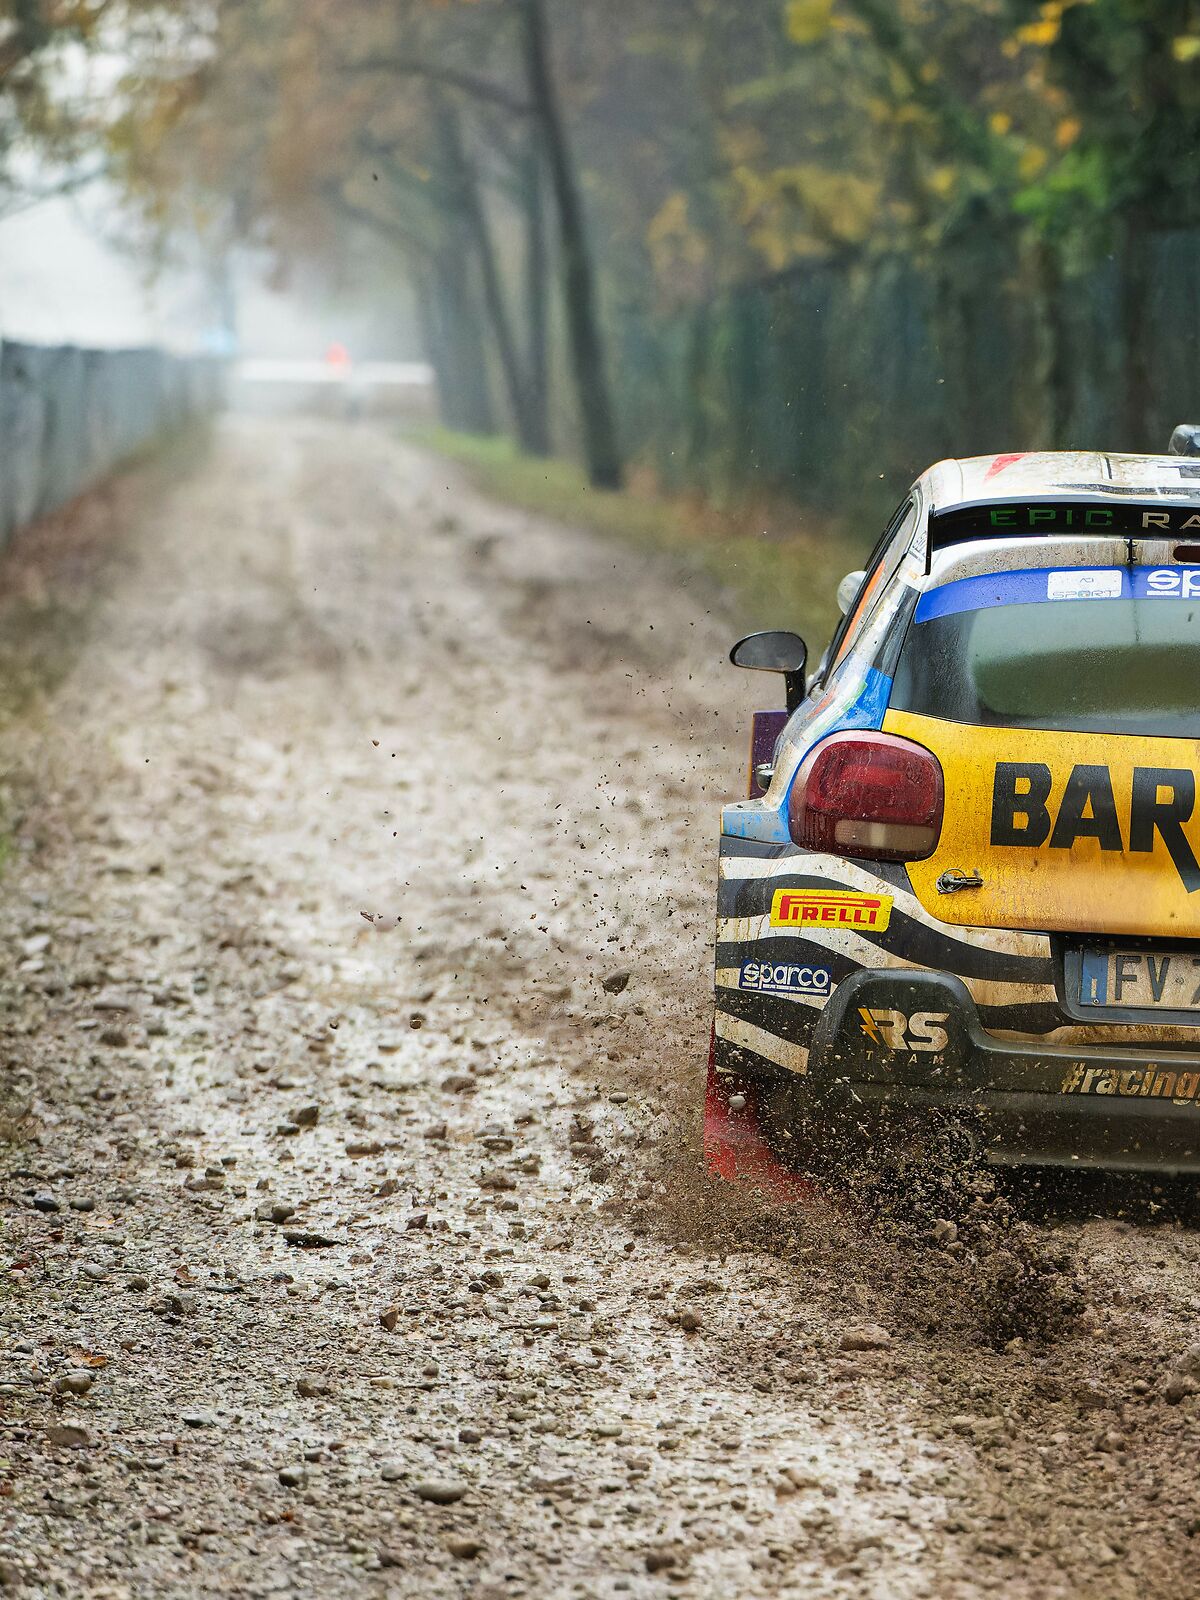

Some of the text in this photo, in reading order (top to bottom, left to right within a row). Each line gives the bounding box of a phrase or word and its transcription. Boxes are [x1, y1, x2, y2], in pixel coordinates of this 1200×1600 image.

[990, 509, 1113, 527] EPIC
[779, 895, 881, 924] PIRELLI
[742, 961, 829, 990] sparco
[1115, 954, 1171, 1002] FV
[864, 1008, 950, 1052] RS
[866, 1050, 944, 1066] TAM
[1061, 1062, 1200, 1106] #racing
